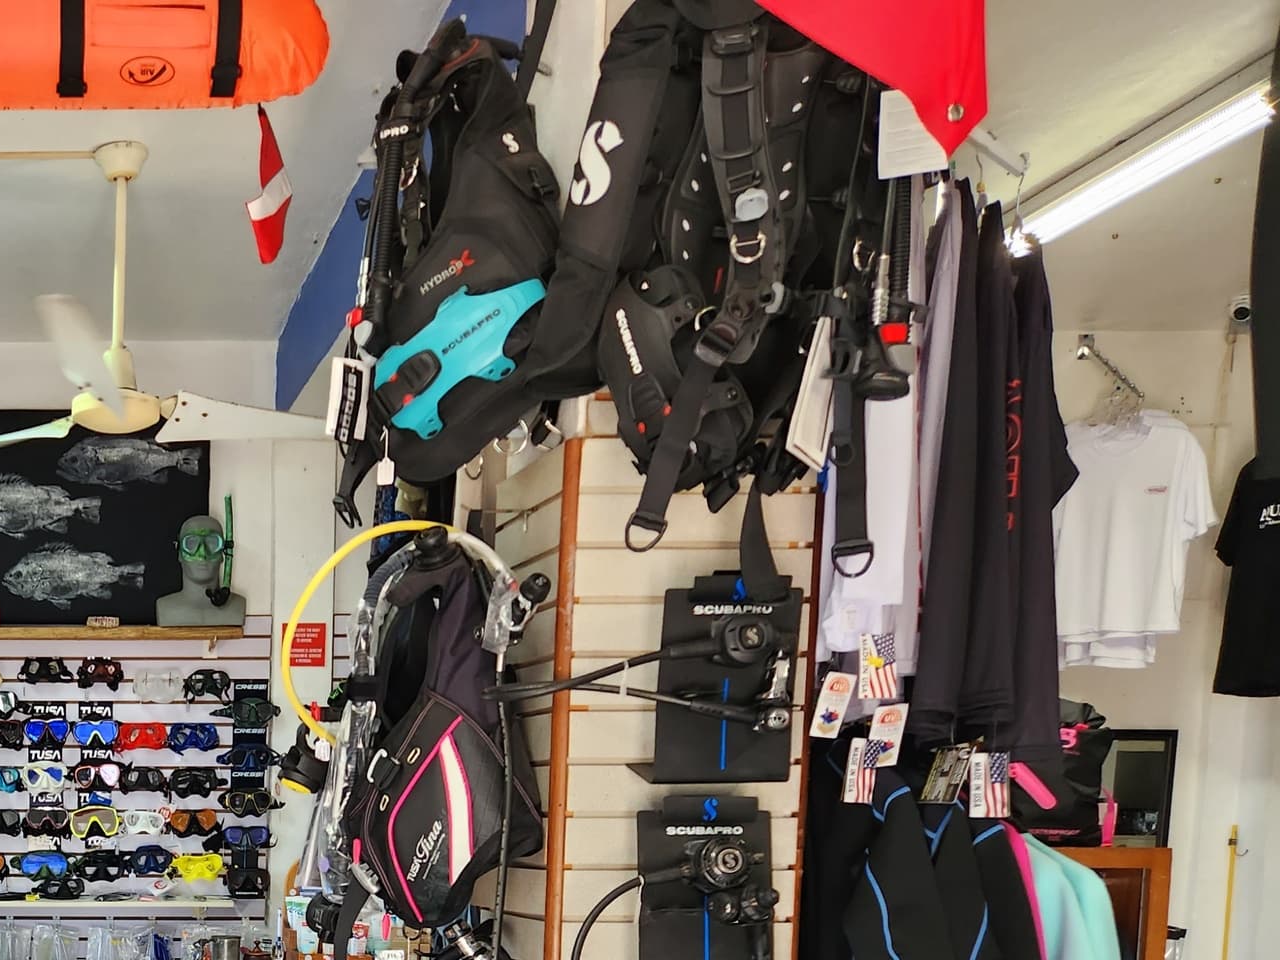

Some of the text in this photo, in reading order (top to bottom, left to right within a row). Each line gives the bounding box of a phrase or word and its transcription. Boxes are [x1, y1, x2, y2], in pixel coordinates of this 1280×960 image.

[441, 308, 502, 355] SCUBAPRO
[615, 308, 643, 375] SCUBAPRO
[693, 605, 773, 615] SCUBAPRO
[30, 749, 61, 760] TUSA
[82, 749, 113, 760] TUSA
[665, 825, 744, 836] SCUBAPRO
[406, 856, 421, 881] TUSA
